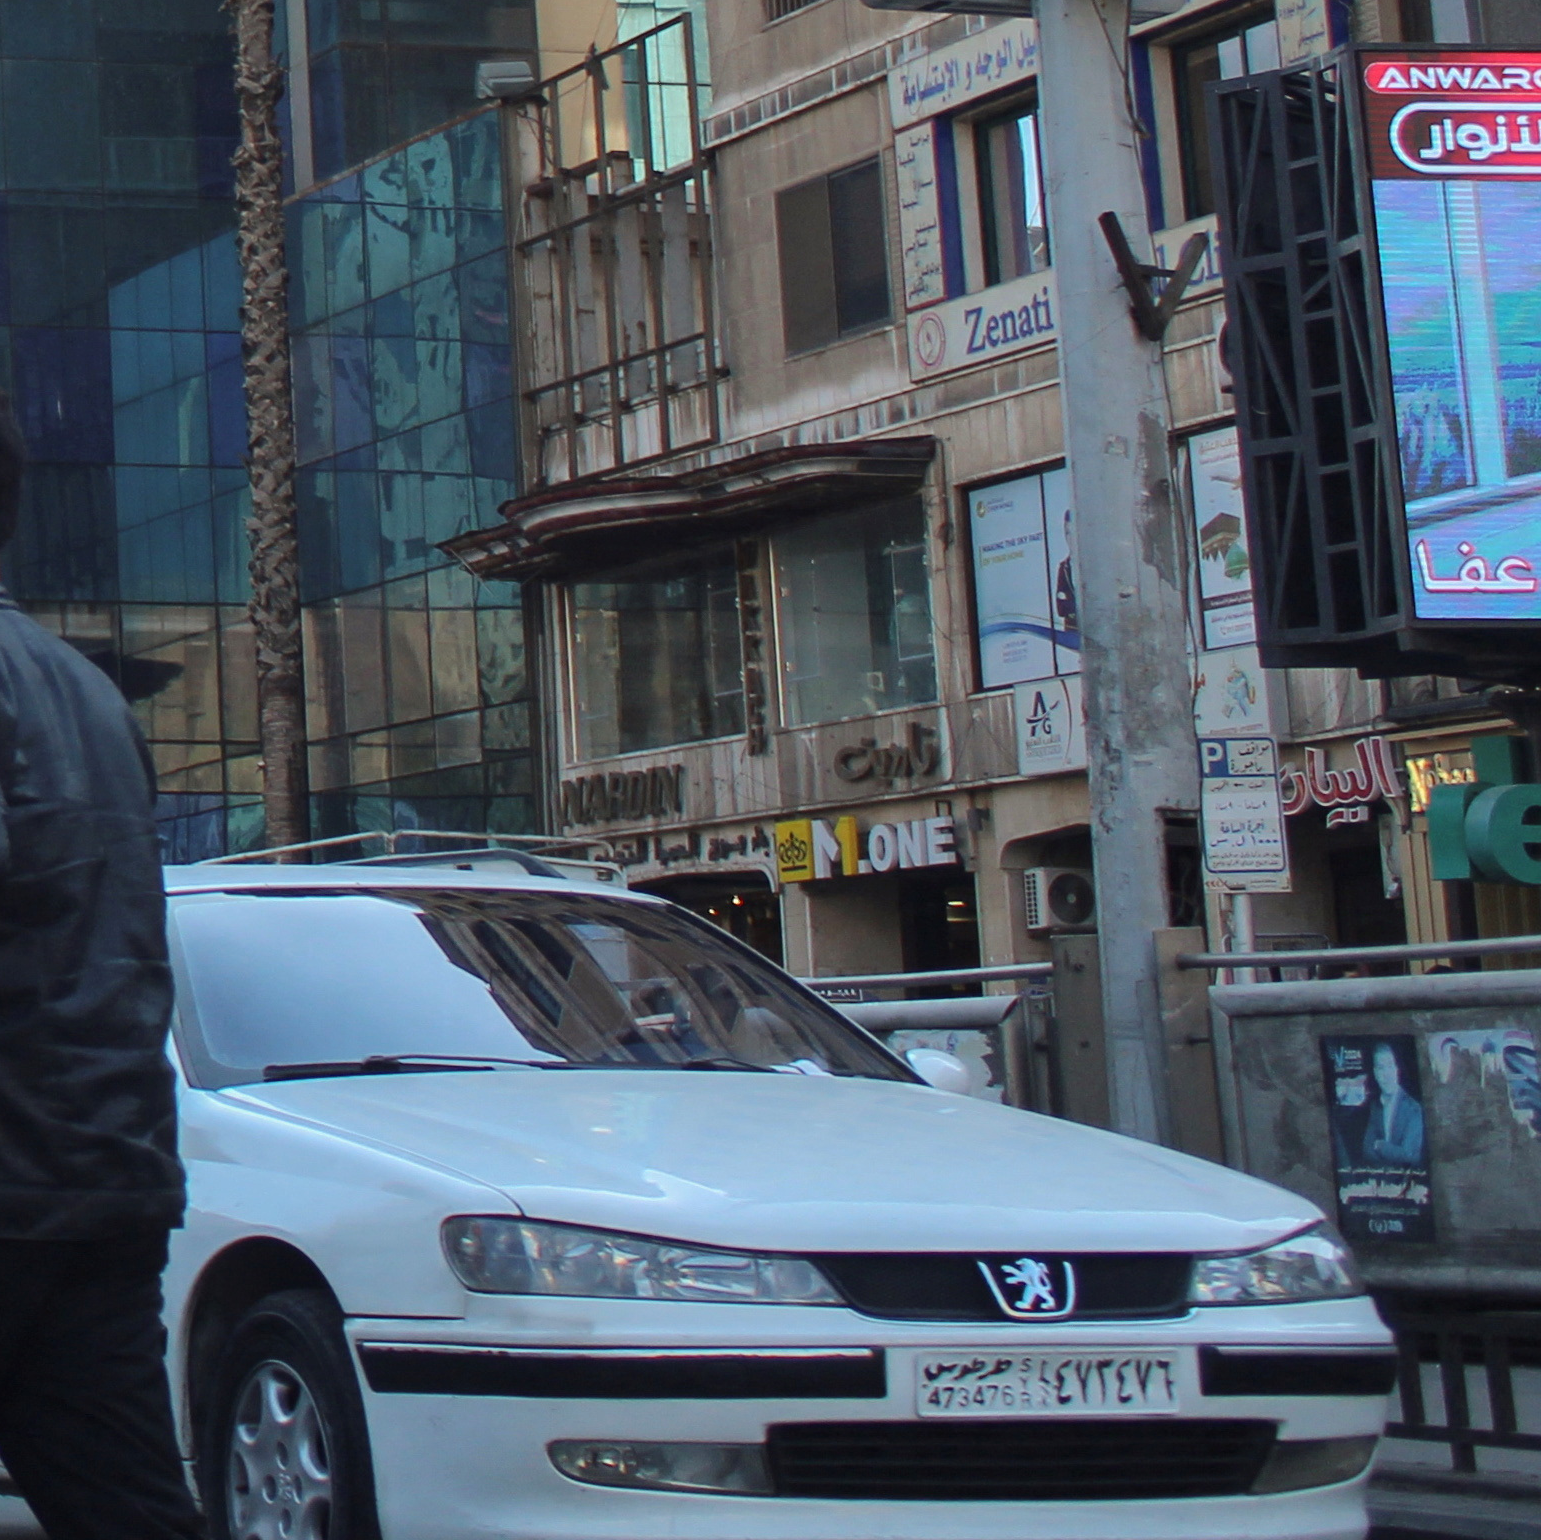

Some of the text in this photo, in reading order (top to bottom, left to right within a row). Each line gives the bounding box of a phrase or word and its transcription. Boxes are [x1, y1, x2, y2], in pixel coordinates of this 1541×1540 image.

[1377, 67, 1541, 90] ANWAR
[1419, 115, 1541, 160] أنوار
[964, 286, 1054, 354] Zenati
[1201, 742, 1223, 773] P
[928, 1384, 1015, 1409] 473476
[1055, 1359, 1174, 1404] ٤٧٣٤٧٦
